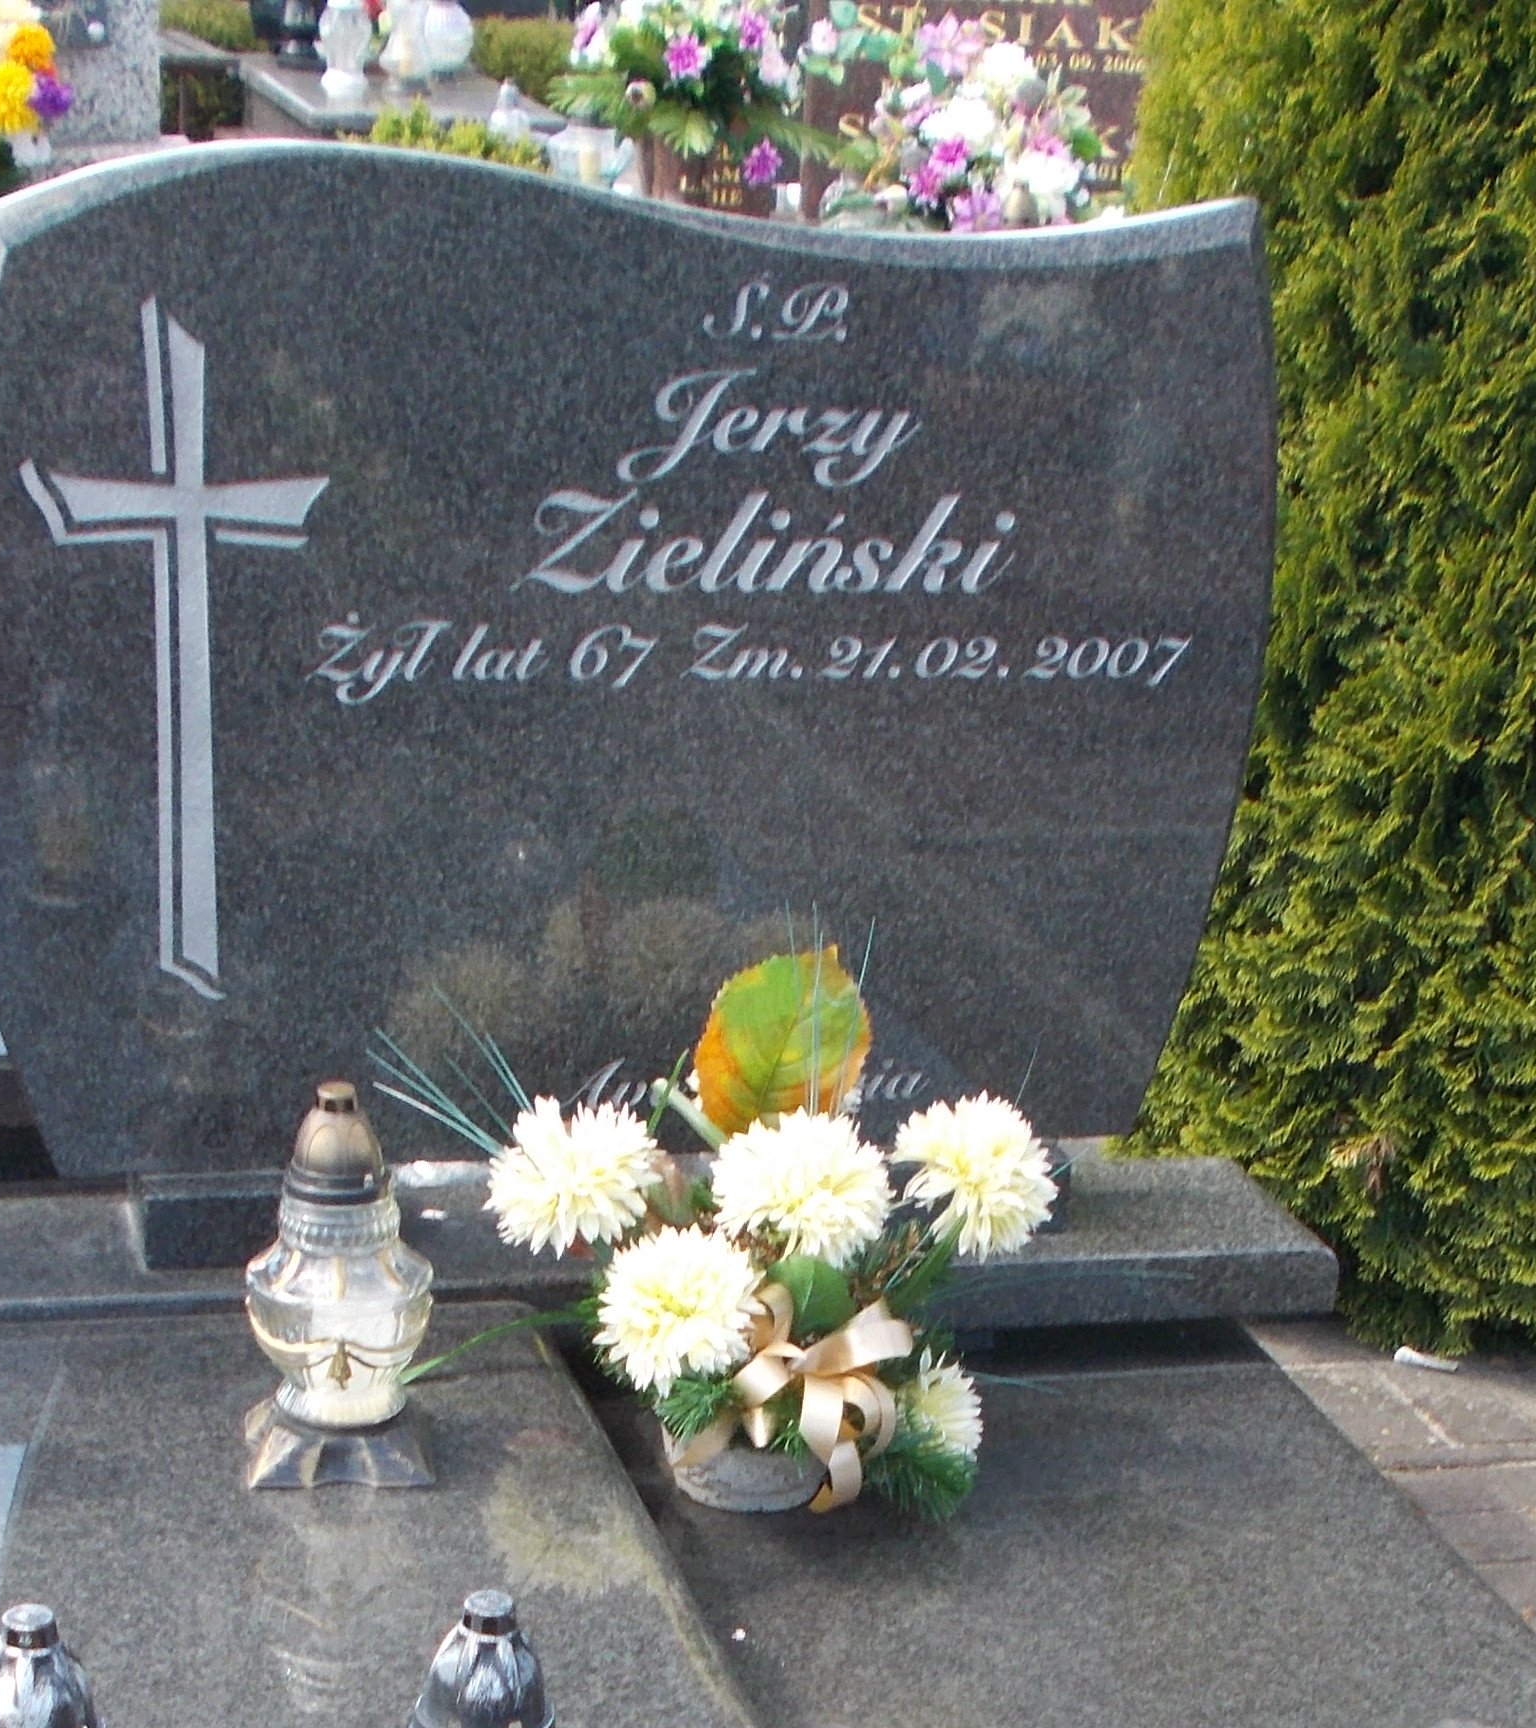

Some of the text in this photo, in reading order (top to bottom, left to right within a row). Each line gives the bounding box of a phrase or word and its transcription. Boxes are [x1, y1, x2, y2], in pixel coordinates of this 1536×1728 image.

[616, 367, 923, 488] Jerzy
[509, 488, 1016, 594] Zieliński
[451, 623, 552, 681] lat
[569, 623, 659, 687] 67
[680, 620, 805, 680] Zm.
